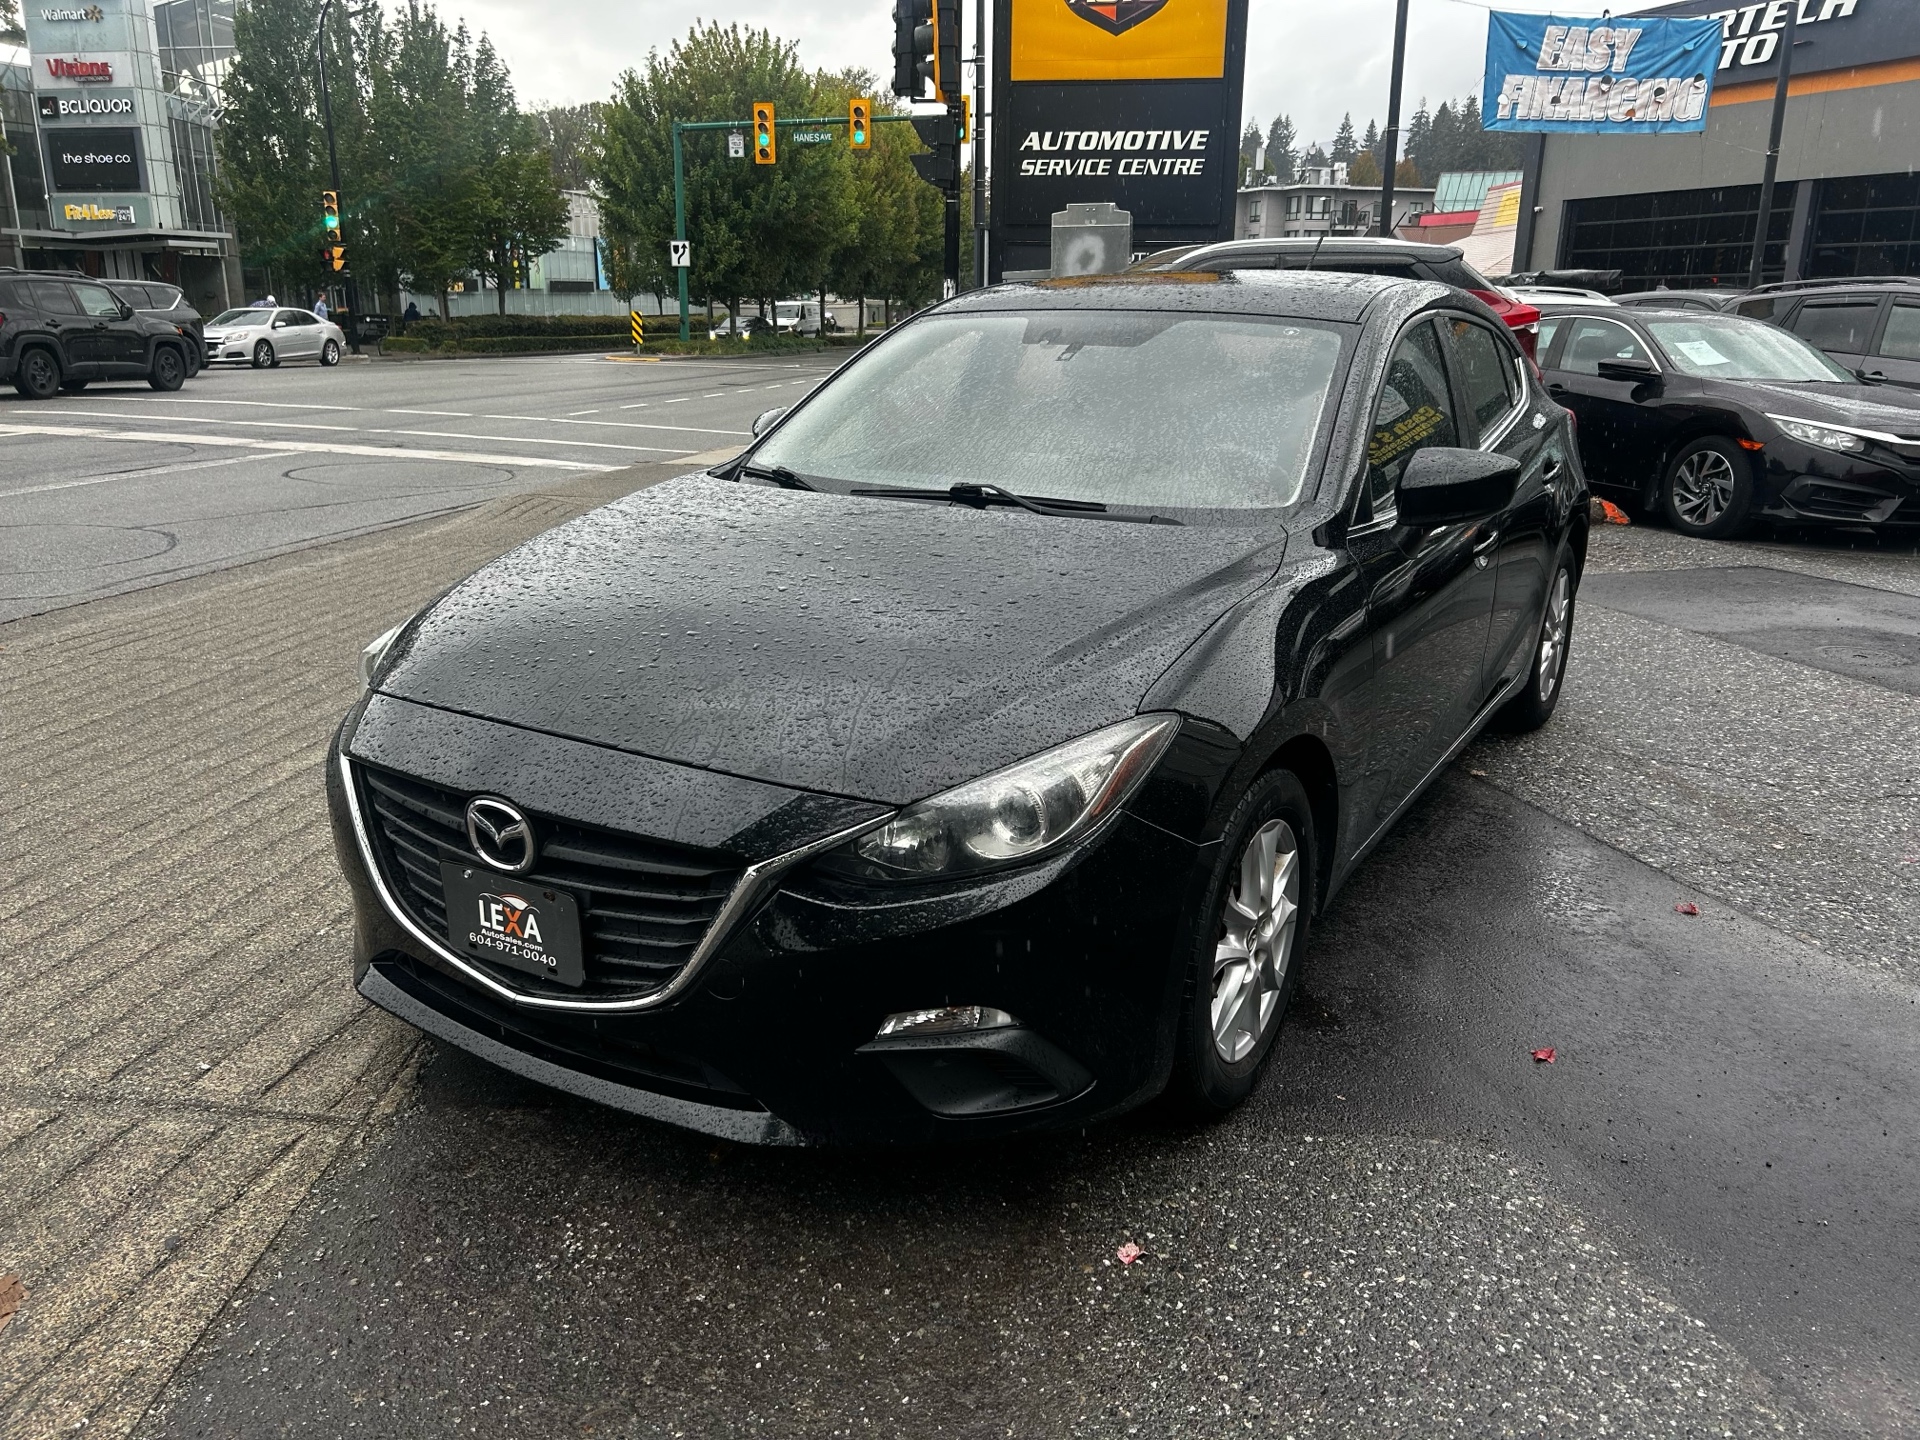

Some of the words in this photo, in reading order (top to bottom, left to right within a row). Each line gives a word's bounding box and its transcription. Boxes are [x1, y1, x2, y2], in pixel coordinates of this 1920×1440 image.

[41, 8, 87, 21] Walmart
[1691, 0, 1858, 38] RTECH
[1536, 25, 1643, 73] EASY
[1717, 32, 1779, 70] TO
[46, 57, 112, 77] Visions
[1497, 73, 1708, 123] FINANCING
[793, 133, 820, 142] HANES
[820, 133, 832, 141] AVE
[1019, 130, 1210, 151] AUTOMOTIVE
[63, 153, 82, 164] the
[84, 153, 113, 164] shoe
[115, 154, 132, 163] co.
[1019, 158, 1113, 176] SERVICE
[1117, 158, 1206, 175] CENTRE
[478, 899, 543, 943] LEXA
[469, 931, 557, 967] 604-971-0040
[481, 928, 543, 952] AutoSales.com
